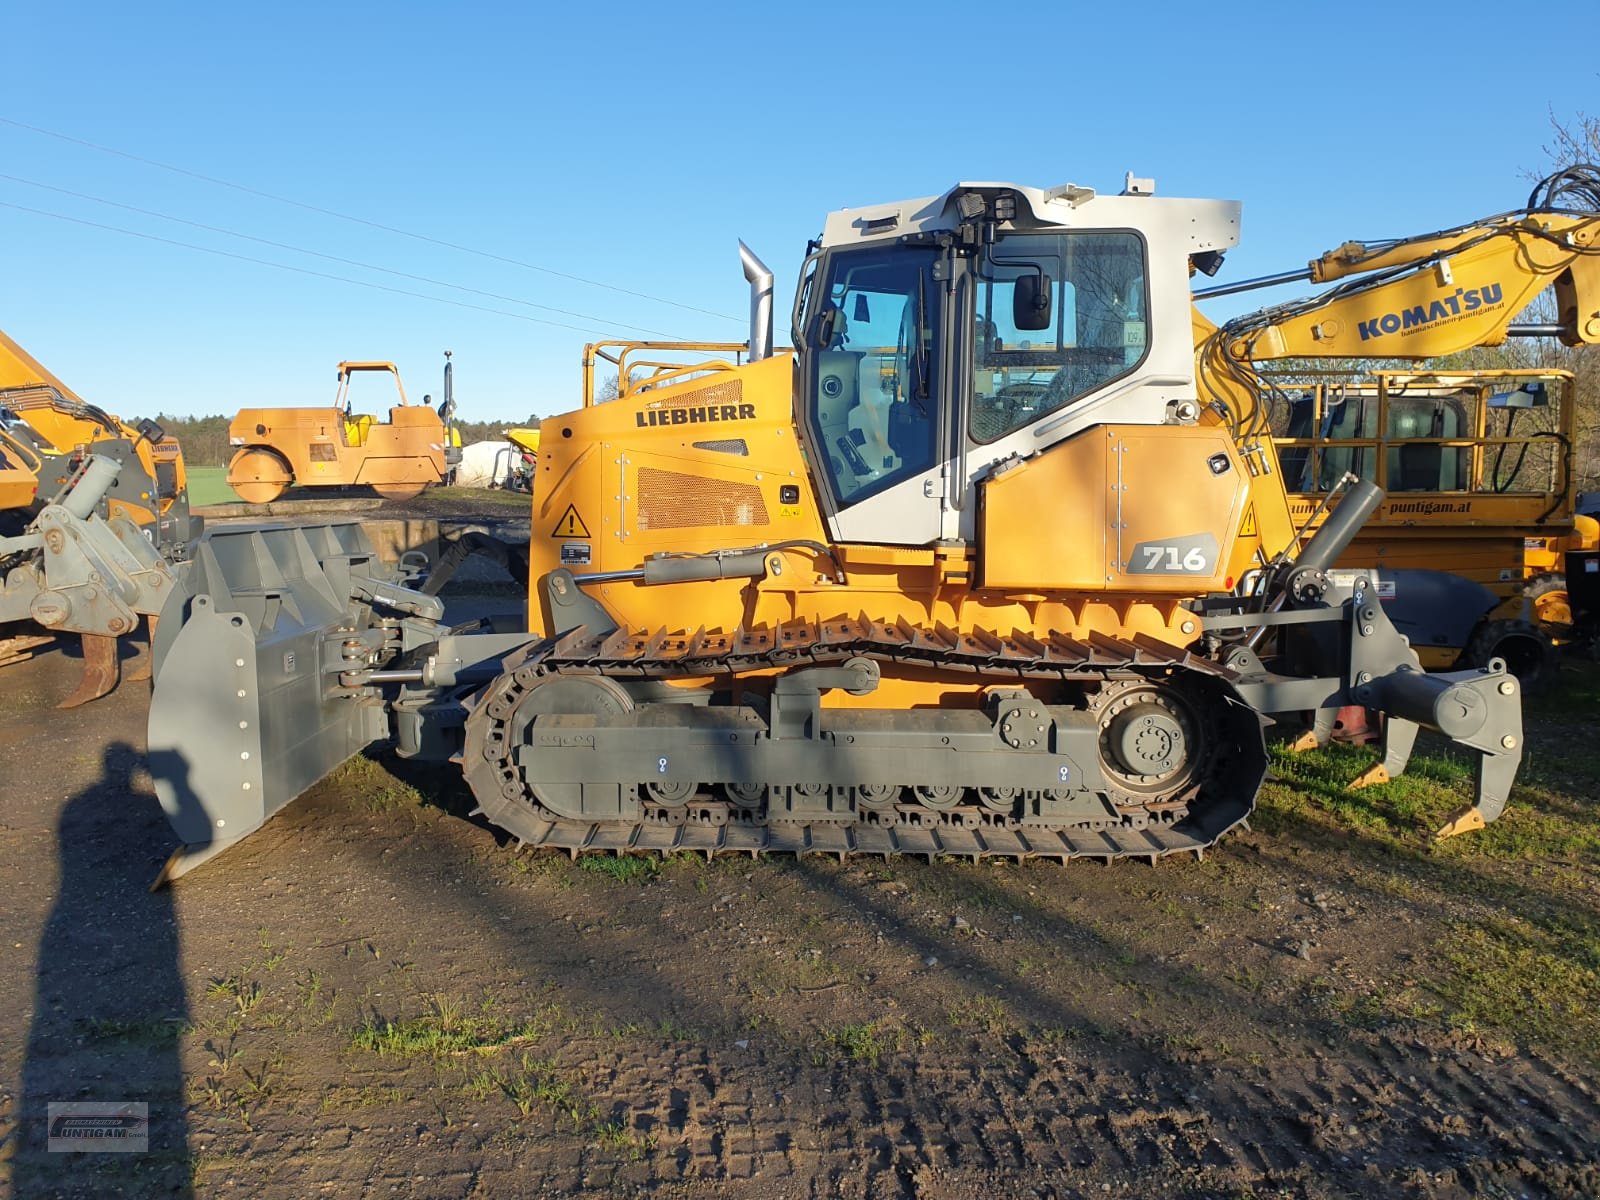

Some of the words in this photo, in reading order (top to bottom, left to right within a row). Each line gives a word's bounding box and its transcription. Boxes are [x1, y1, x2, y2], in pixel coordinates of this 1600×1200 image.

[1358, 282, 1504, 341] KOMATSU
[636, 403, 757, 427] LIEBHERR
[1389, 501, 1472, 516] puntigam.at
[1143, 546, 1206, 571] 716
